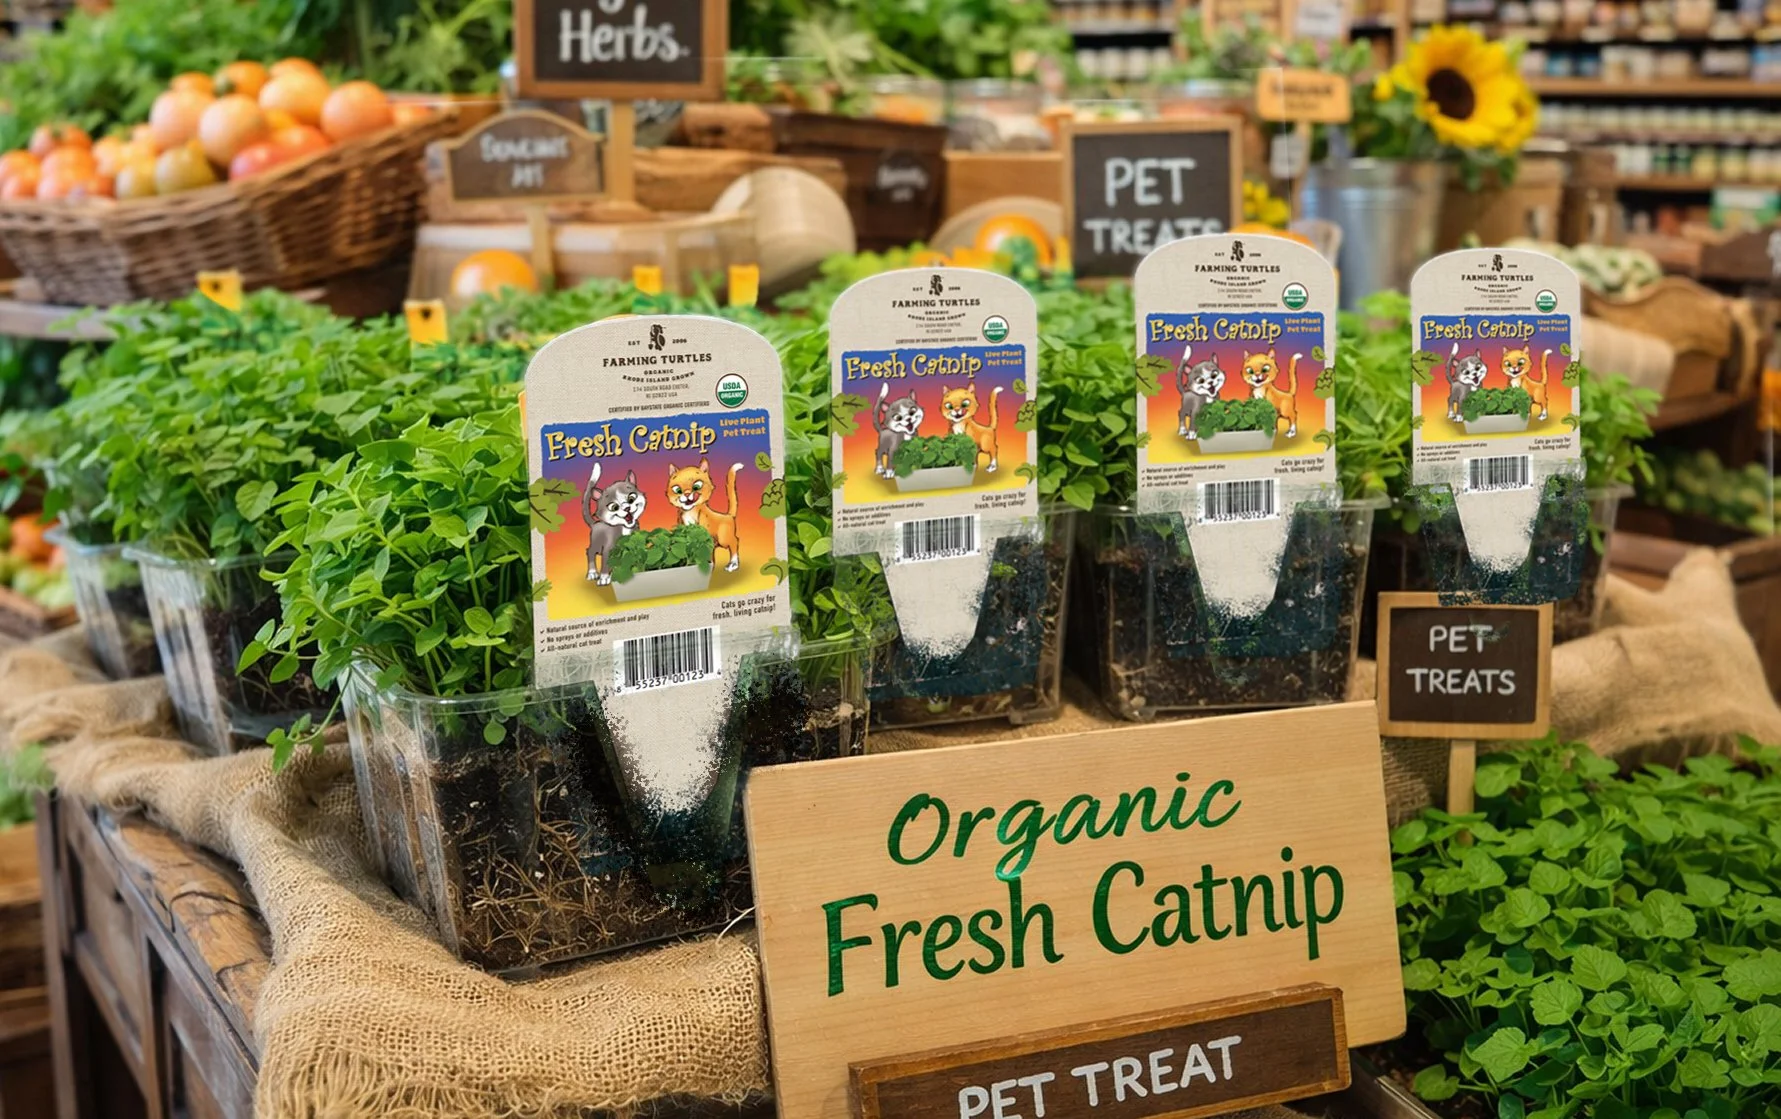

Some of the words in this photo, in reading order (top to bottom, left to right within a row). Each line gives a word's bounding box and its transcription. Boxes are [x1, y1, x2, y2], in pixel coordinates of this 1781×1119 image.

[1104, 157, 1197, 207] PET
[892, 300, 936, 308] FARMING
[1149, 315, 1209, 343] Fresh
[1213, 318, 1282, 345] Catnip
[1423, 317, 1473, 341] Fresh
[1477, 319, 1535, 342] Catnip
[603, 356, 657, 367] FARMING
[661, 353, 712, 364] TURTLES
[844, 352, 907, 380] Fresh
[911, 352, 983, 379] Catnip
[720, 391, 744, 399] ORGANIC
[722, 382, 741, 390] USDA
[720, 418, 739, 426] Live
[740, 416, 765, 424] Plant
[544, 423, 623, 462] Fresh
[628, 421, 717, 454] Catnip
[723, 428, 739, 437] Pet
[740, 426, 766, 436] Treat
[721, 601, 736, 609] Cats
[737, 600, 746, 609] go
[747, 597, 765, 605] crazy
[766, 594, 776, 602] for
[733, 608, 752, 616] living
[753, 603, 776, 614] catnip!
[546, 625, 567, 633] Natural
[568, 623, 587, 631] source
[595, 616, 626, 626] enrichment
[638, 613, 650, 622] play
[547, 642, 578, 652] All-natural
[579, 640, 588, 648] cat
[588, 638, 602, 646] treat
[556, 634, 574, 642] sprays
[583, 629, 608, 638] additives
[1429, 624, 1493, 653] PET
[635, 676, 668, 690] 55237
[672, 670, 704, 684] 00123
[1406, 668, 1516, 695] TREATS
[887, 771, 1242, 881] Organic
[823, 877, 1065, 997] Fresh
[1093, 846, 1345, 961] Catnip
[958, 1072, 1056, 1119] PET
[1070, 1035, 1242, 1107] TREAT
